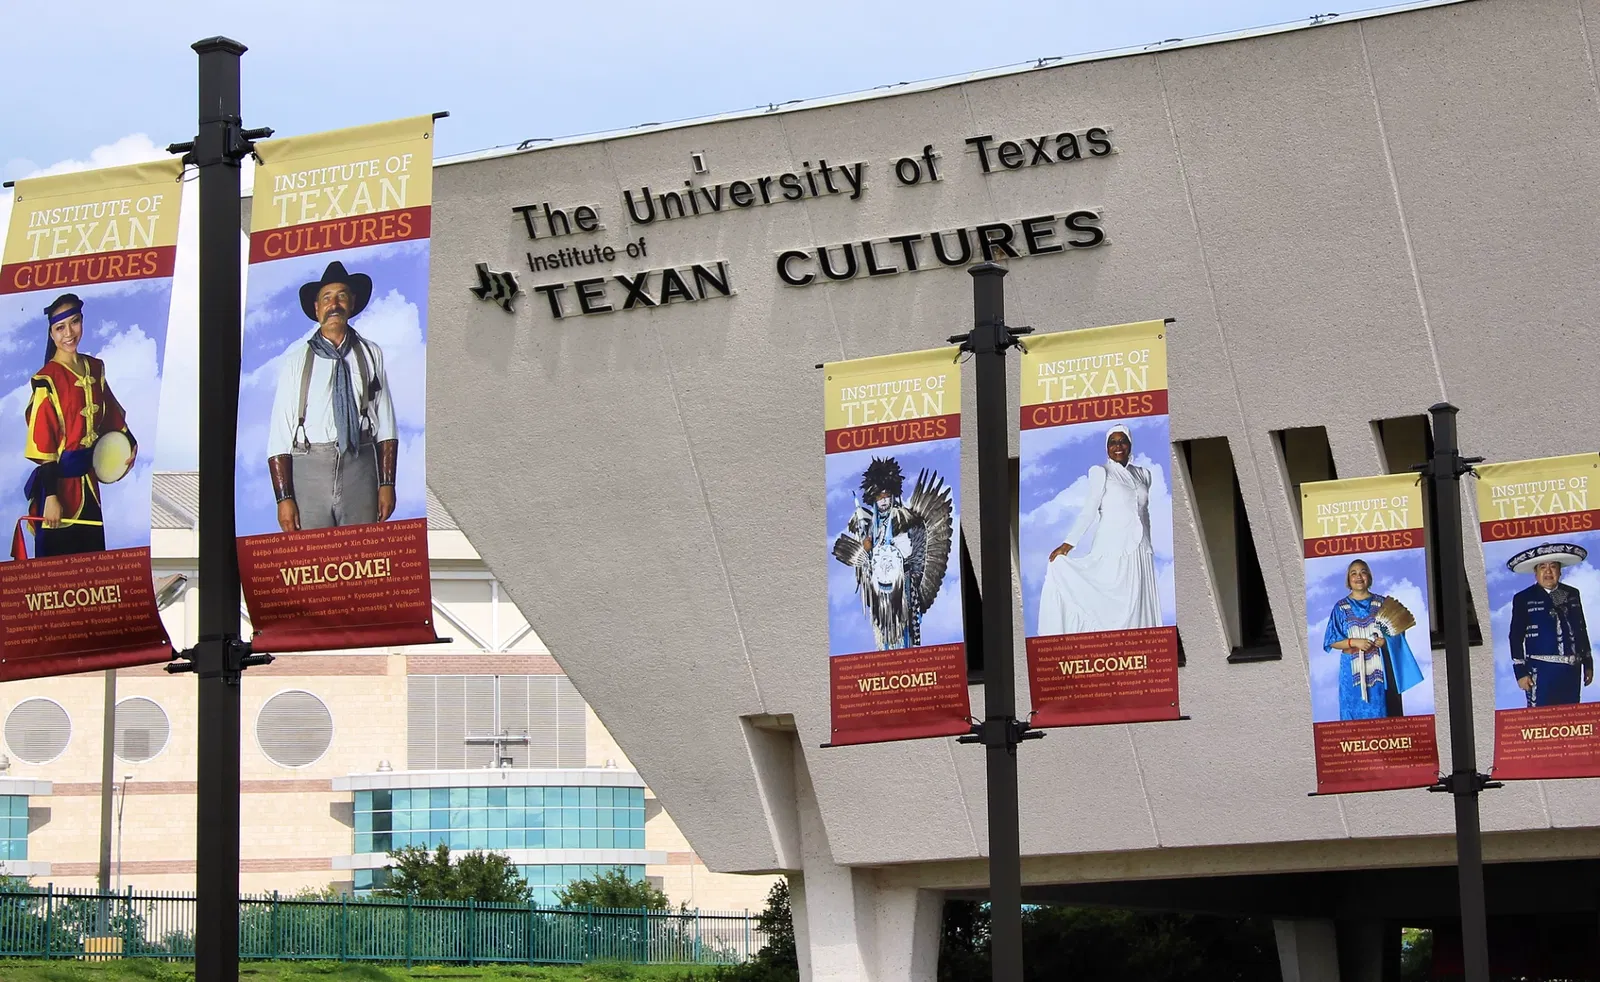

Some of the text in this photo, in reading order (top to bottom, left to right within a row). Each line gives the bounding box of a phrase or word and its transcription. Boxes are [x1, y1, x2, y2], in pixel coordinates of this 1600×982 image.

[274, 154, 412, 192] INSTITUTE OF
[511, 127, 1113, 240] The University of Texas
[29, 195, 163, 228] INSTITUTE OF
[272, 175, 410, 228] TEXAN
[26, 215, 159, 260] TEXAN
[264, 212, 412, 257] CULTURES
[526, 237, 648, 272] Institute of
[533, 210, 1106, 319] TEXAN CULTURES
[14, 252, 157, 289] CULTURES
[1038, 350, 1149, 376] INSTITUTE OF
[841, 375, 946, 401] INSTITUTE OF
[1038, 365, 1148, 403] TEXAN
[841, 390, 944, 427] TEXAN
[1032, 395, 1153, 426] CULTURES
[837, 419, 947, 449] CULTURES
[1492, 476, 1588, 497] INSTITUTE OF
[1317, 496, 1408, 515] INSTITUTE OF
[1492, 490, 1588, 520] TEXAN
[244, 522, 422, 546] Bienvenido Willkommen Shalom Aloha Akwaaba
[1317, 509, 1408, 536] TEXAN
[1491, 514, 1592, 538] CULTURES
[306, 542, 342, 551] Bienvenuto
[1314, 532, 1412, 554] CULTURES
[31, 560, 64, 568] Willkommen
[70, 556, 91, 564] Shalom
[98, 553, 114, 561] Aloha
[121, 549, 147, 558] Akwaaba
[253, 561, 282, 569] Mabuhay
[318, 555, 340, 563] Yukwe
[340, 553, 353, 562] yuk
[360, 549, 397, 559] Benvinguts
[47, 568, 78, 578] Bienvenuto
[85, 566, 95, 574] Xin
[251, 575, 275, 583] Witamy
[280, 558, 390, 586] WELCOME!
[364, 578, 378, 587] ying
[410, 573, 423, 581] vini
[2, 588, 27, 596] Mabuhay
[77, 580, 88, 589] yuk
[25, 585, 121, 611] WELCOME!
[353, 591, 384, 600] Kyosopae
[400, 586, 420, 595] napot
[327, 607, 349, 615] datang
[1058, 655, 1147, 675] WELCOME!
[858, 672, 937, 692] WELCOME!
[1340, 737, 1412, 753] WELCOME!
[1521, 724, 1593, 740] WELCOME!
